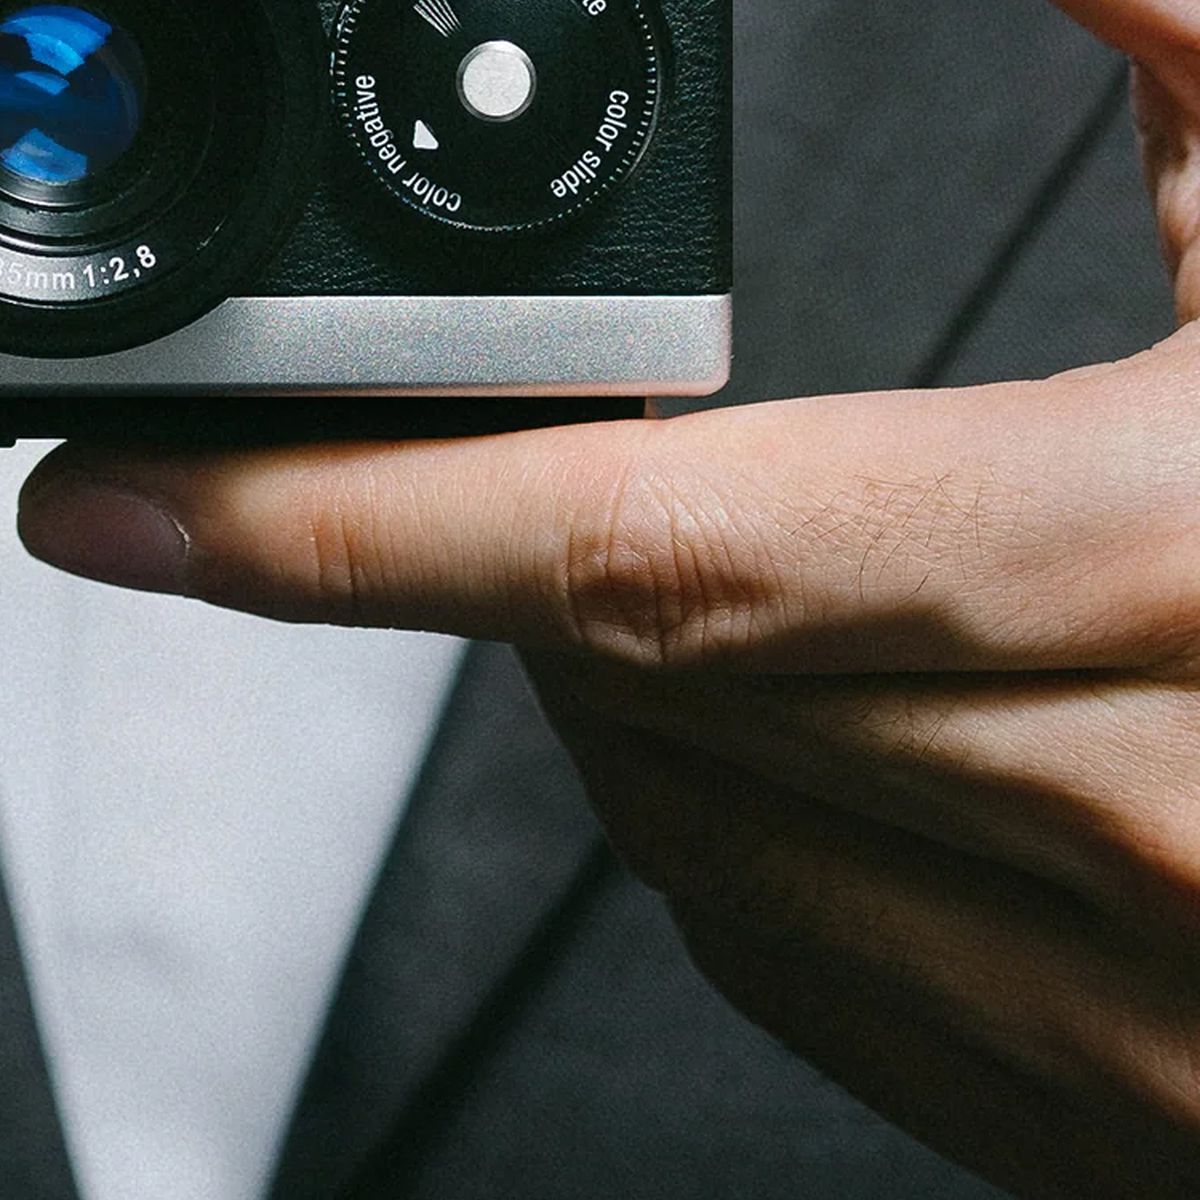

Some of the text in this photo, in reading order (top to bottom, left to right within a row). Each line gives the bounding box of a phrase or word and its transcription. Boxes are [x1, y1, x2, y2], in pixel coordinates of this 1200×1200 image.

[354, 74, 462, 213] color negative
[550, 89, 630, 198] color slide
[82, 244, 157, 288] 1:2,8
